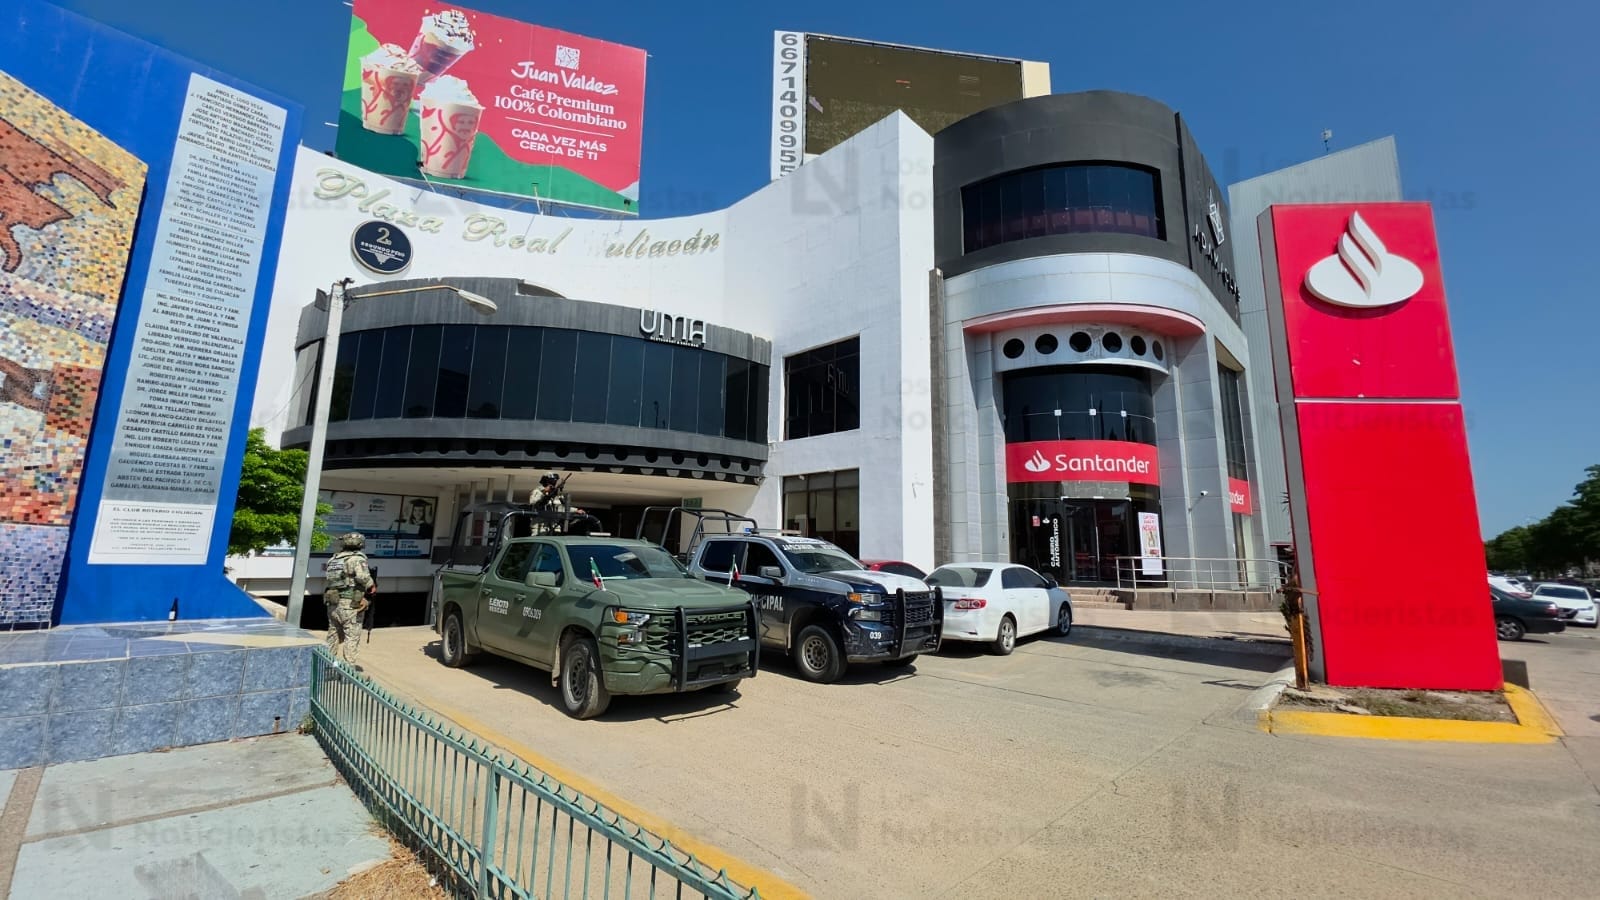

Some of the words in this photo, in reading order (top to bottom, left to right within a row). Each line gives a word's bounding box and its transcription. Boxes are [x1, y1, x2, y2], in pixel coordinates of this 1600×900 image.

[512, 60, 561, 86] Juan
[560, 69, 618, 96] Valdez
[494, 95, 536, 114] 100%
[537, 102, 627, 130] Colombiano
[510, 84, 546, 103] Café
[546, 92, 614, 116] Premium
[512, 128, 549, 142] CADA
[551, 134, 578, 148] VEZ
[578, 136, 608, 152] MÁS
[519, 140, 564, 155] CERCA
[566, 147, 585, 158] DE
[586, 150, 598, 161] TI
[313, 166, 444, 234] Plaza
[462, 213, 573, 254] Real
[640, 308, 707, 344] UMA
[1056, 454, 1150, 474] Santander
[870, 631, 882, 639] 039
